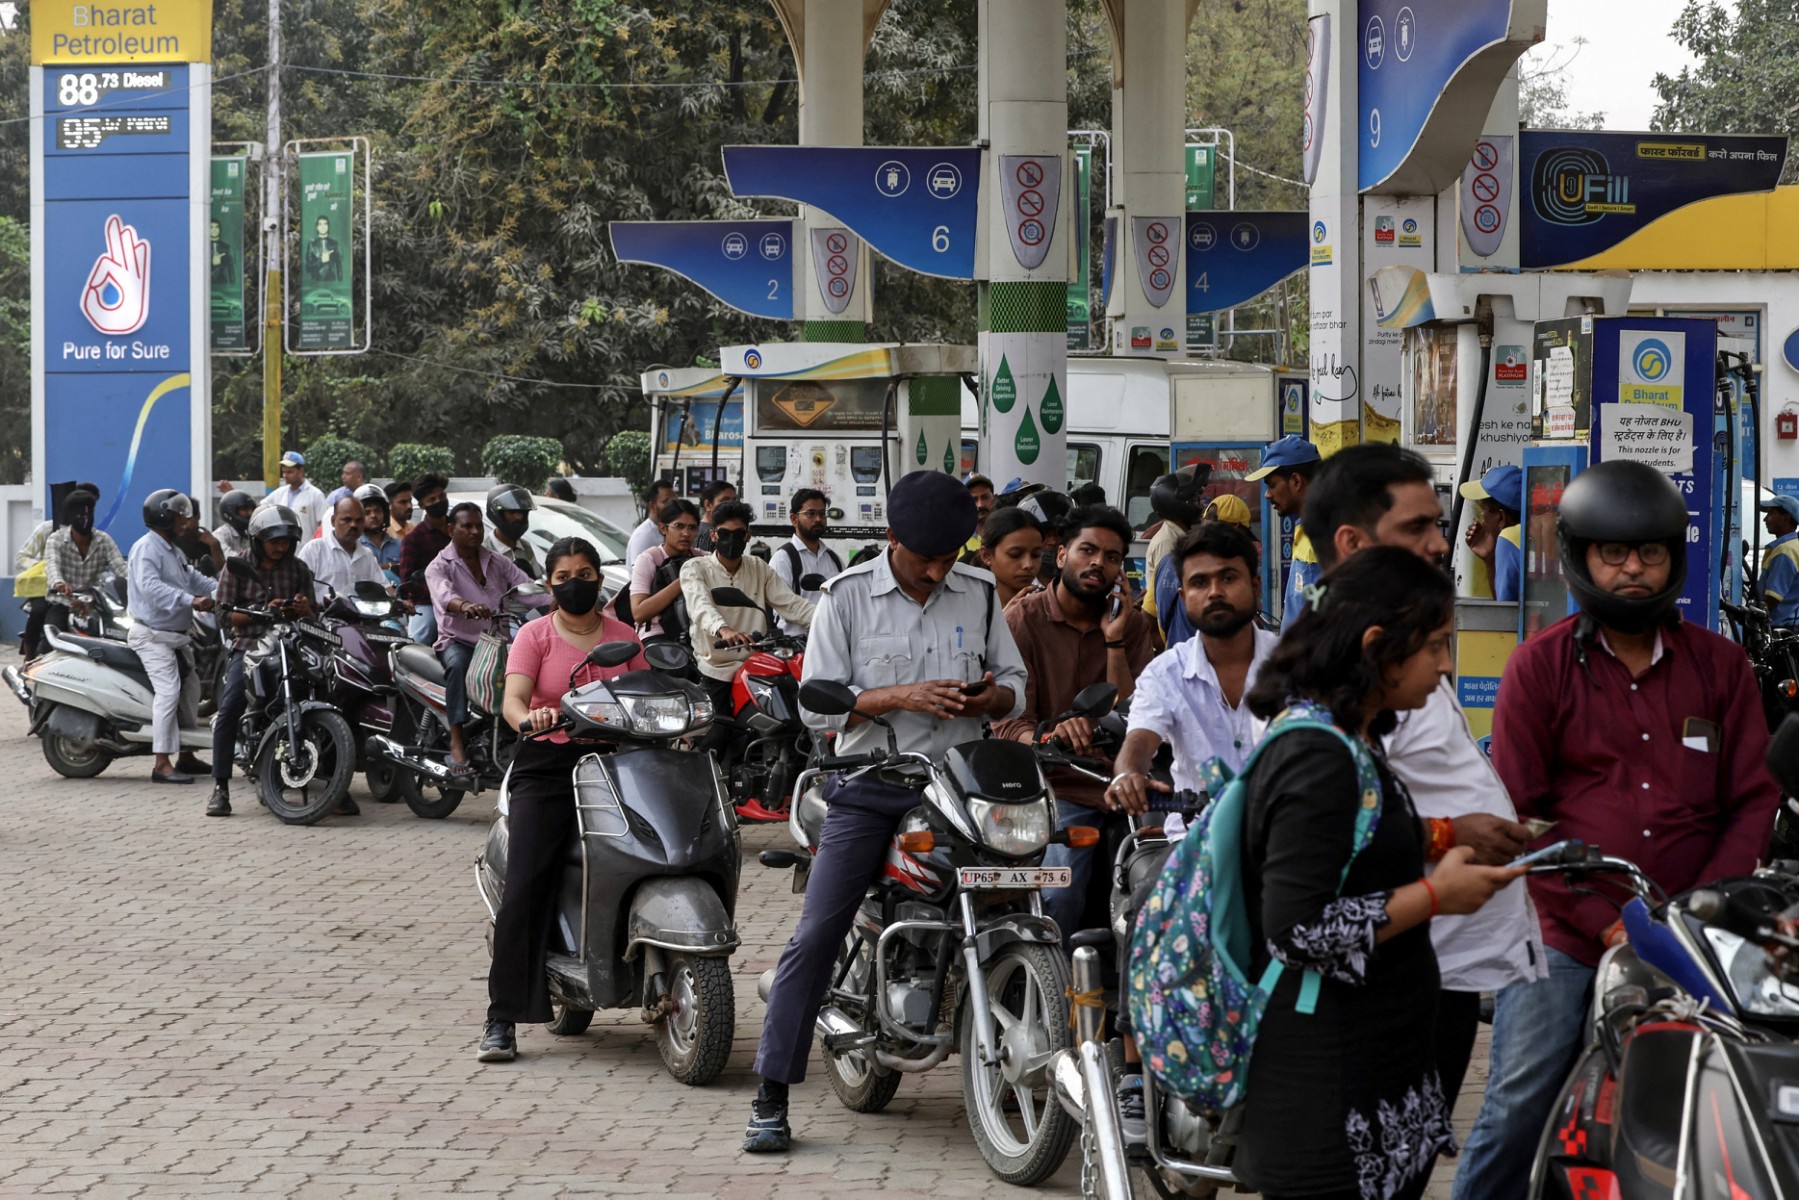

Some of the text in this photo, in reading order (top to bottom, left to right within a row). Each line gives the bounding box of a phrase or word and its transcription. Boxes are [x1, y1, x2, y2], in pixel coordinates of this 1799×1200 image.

[73, 5, 156, 27] Bharat
[53, 33, 179, 56] Petroleum
[123, 72, 163, 88] Diesel
[1370, 108, 1381, 148] 9
[1640, 146, 1777, 162] फास्ट फॉरवर्ड करो अपना फिल
[1560, 173, 1629, 203] UFill
[932, 225, 950, 253] 6
[767, 279, 778, 300] 2
[1194, 271, 1210, 293] 4
[1322, 311, 1333, 319] par
[1329, 321, 1347, 329] bhar
[63, 342, 170, 360] Pure for Sure
[1633, 388, 1669, 400] Bharat
[1479, 420, 1531, 430] esh ke na
[1619, 414, 1682, 427] यह नोजल BHU
[1646, 428, 1657, 440] के
[1656, 429, 1675, 442] लिए
[1618, 445, 1682, 456] This nozzle is for
[964, 872, 994, 883] UP65
[1010, 872, 1028, 883] AX
